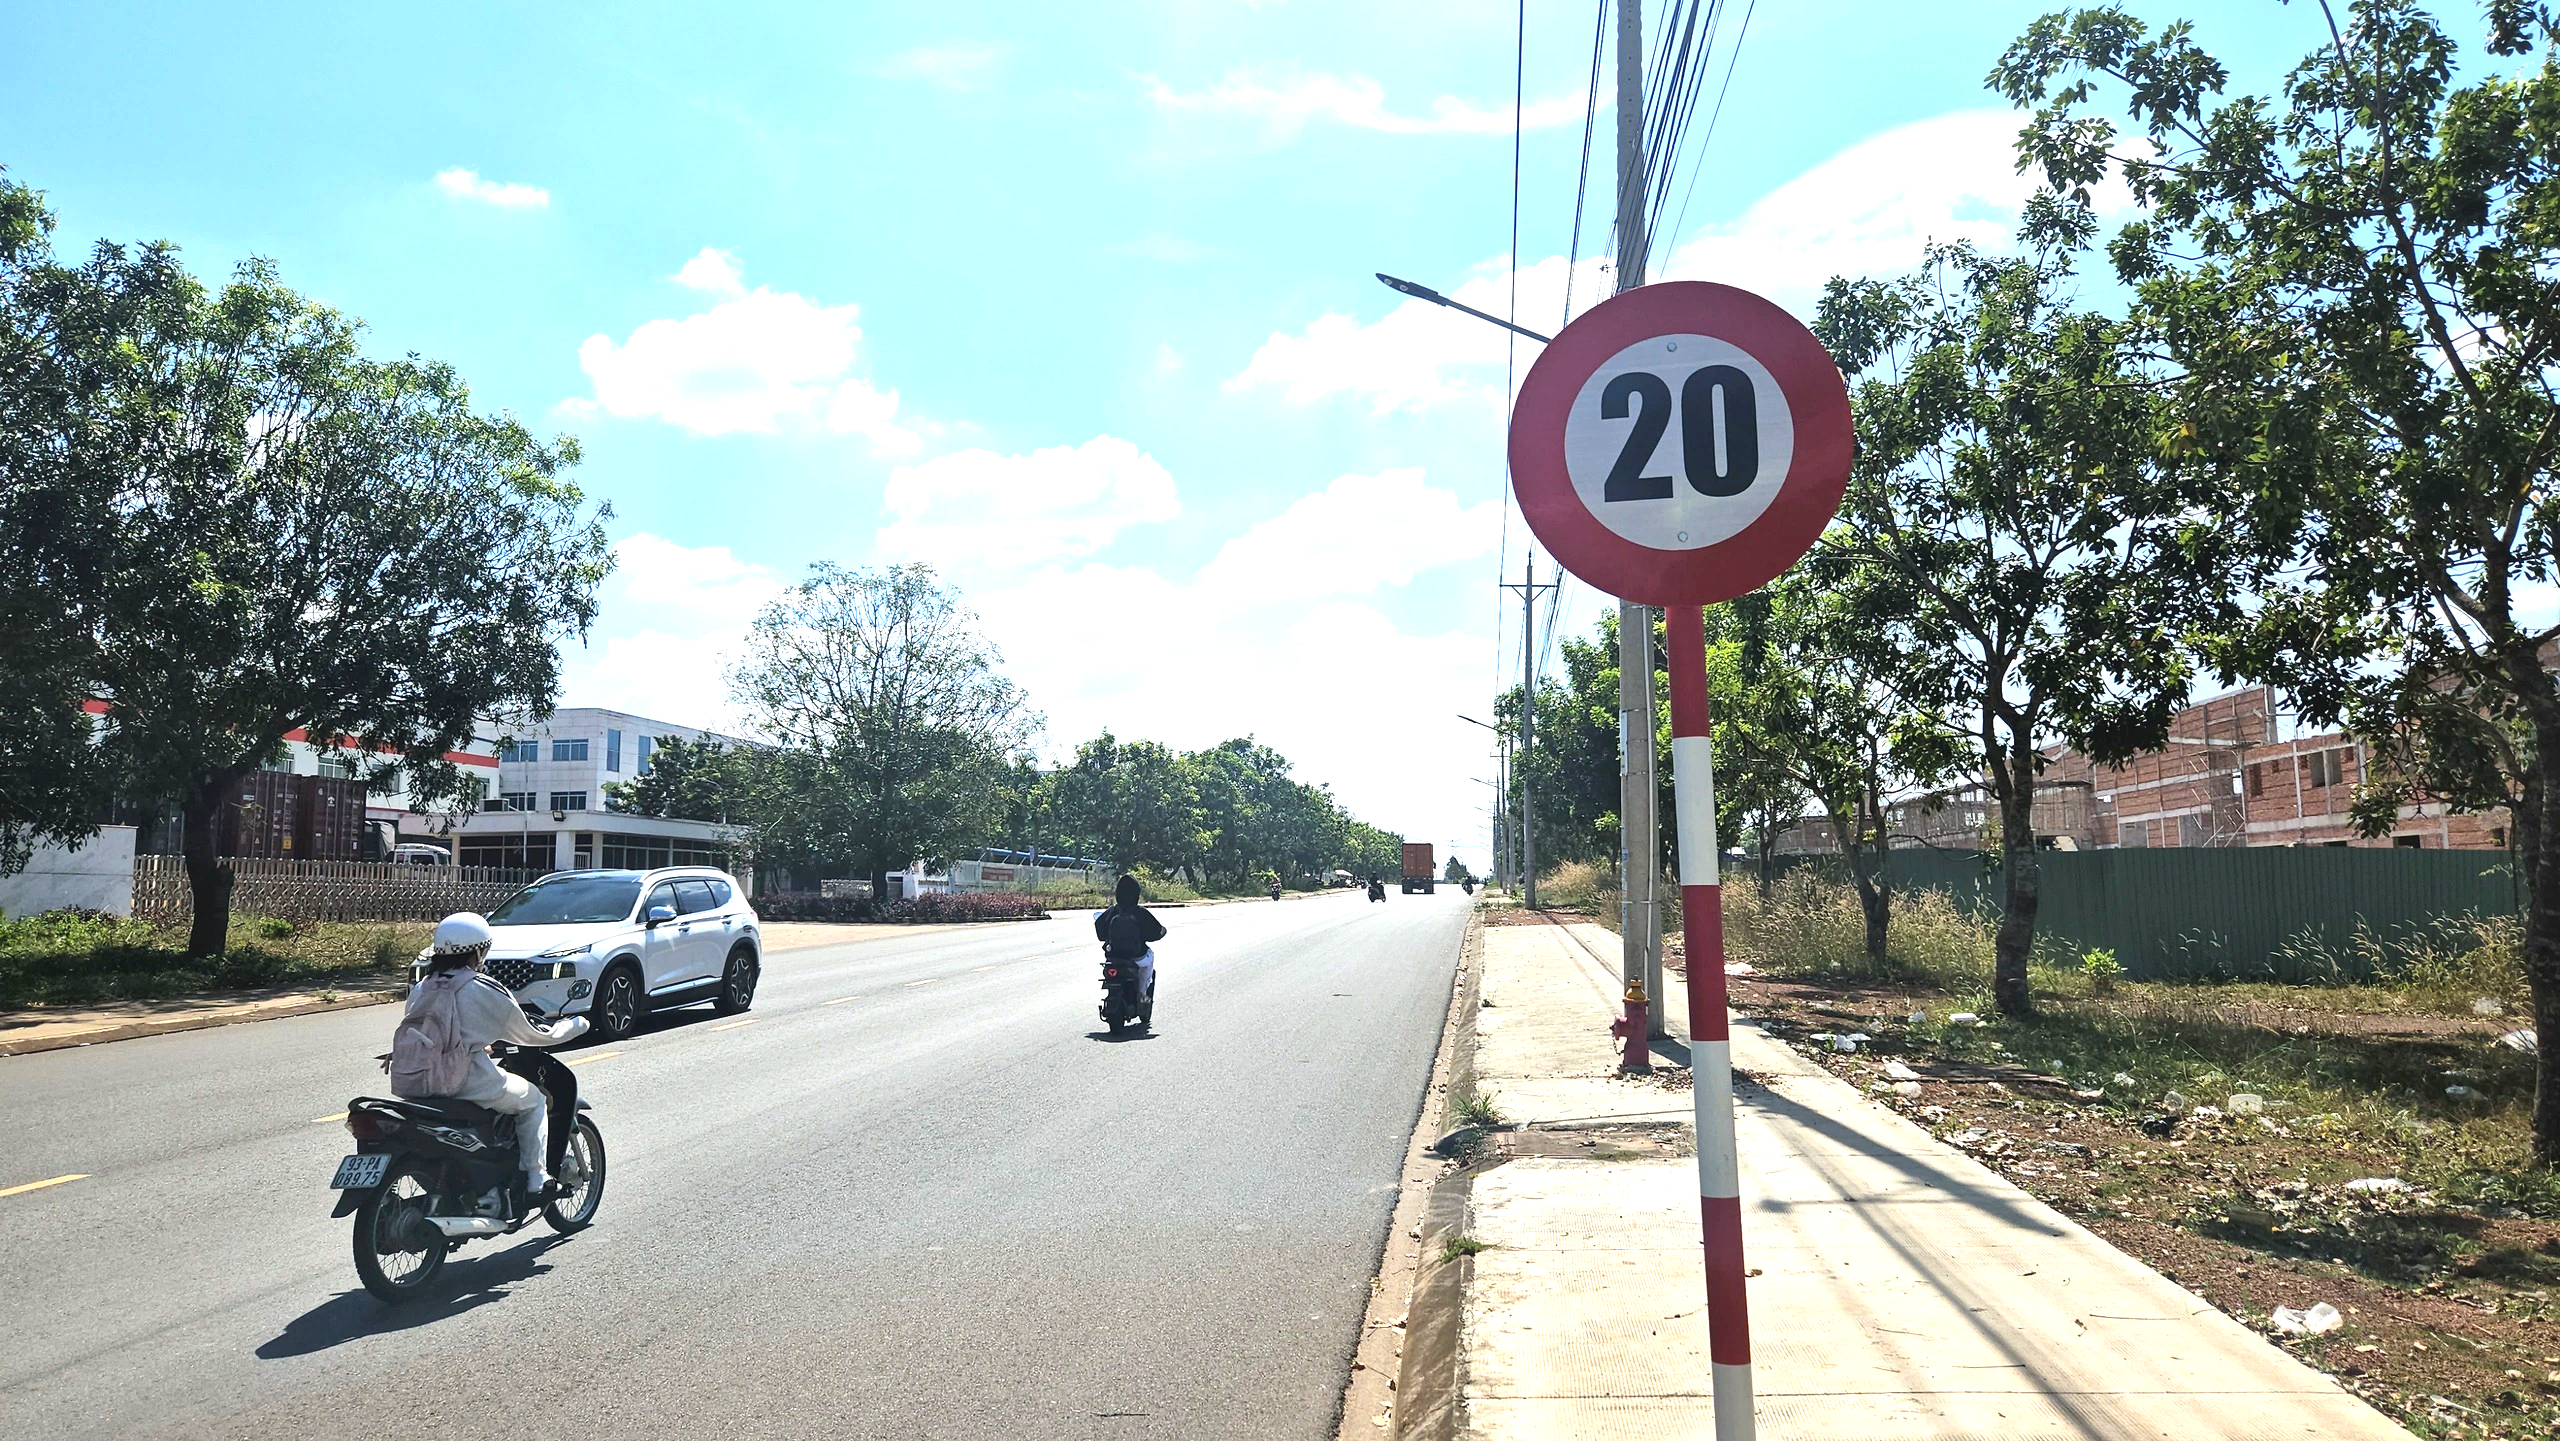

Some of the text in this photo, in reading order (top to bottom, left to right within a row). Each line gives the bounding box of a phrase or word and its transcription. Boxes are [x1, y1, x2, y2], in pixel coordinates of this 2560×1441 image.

[1601, 364, 1759, 503] 20
[347, 1157, 381, 1171] 93-PA
[335, 1171, 380, 1186] 089.75
